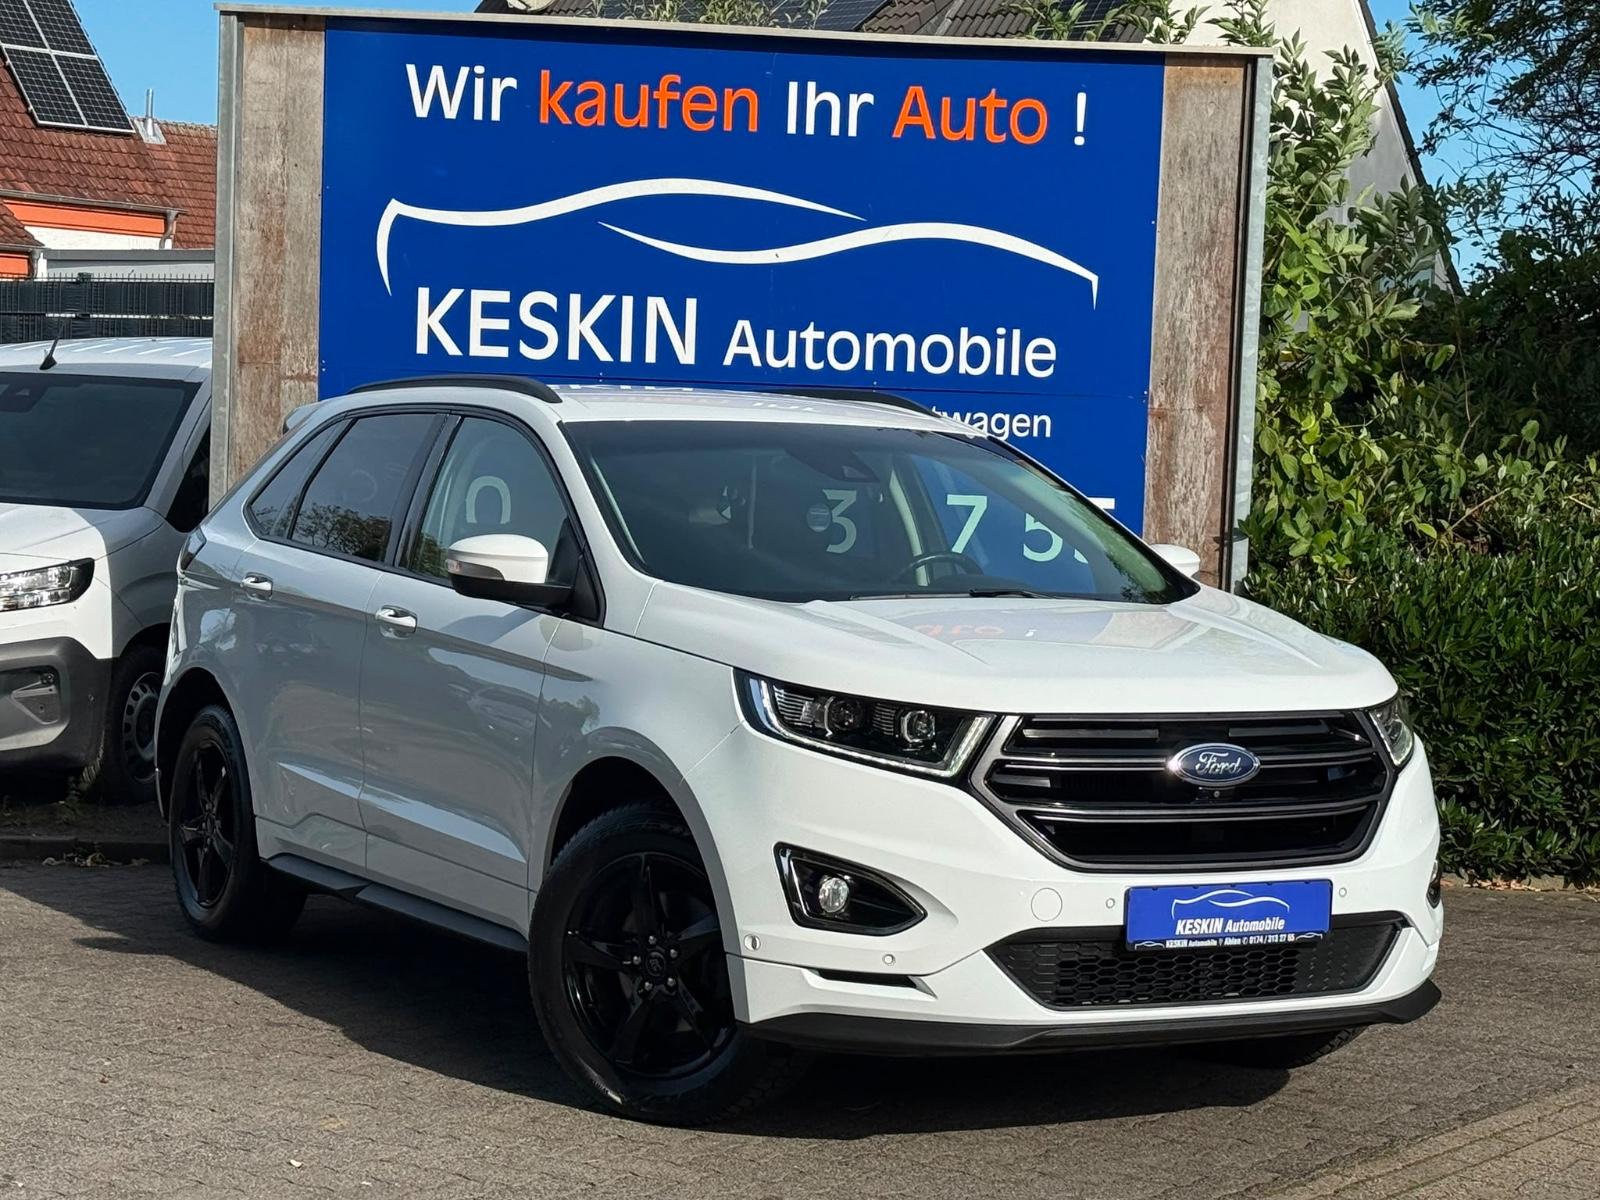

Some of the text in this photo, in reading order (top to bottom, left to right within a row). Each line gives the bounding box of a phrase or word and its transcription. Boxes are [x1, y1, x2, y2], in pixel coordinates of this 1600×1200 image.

[406, 64, 517, 122] Wir
[538, 69, 759, 133] kaufen
[787, 81, 875, 137] Ihr
[893, 85, 1048, 145] Auto
[416, 287, 1057, 378] KESKIN Automobile
[931, 406, 1051, 441] wagen
[1195, 751, 1242, 775] Ford
[1176, 917, 1285, 935] KESKIN Automobile
